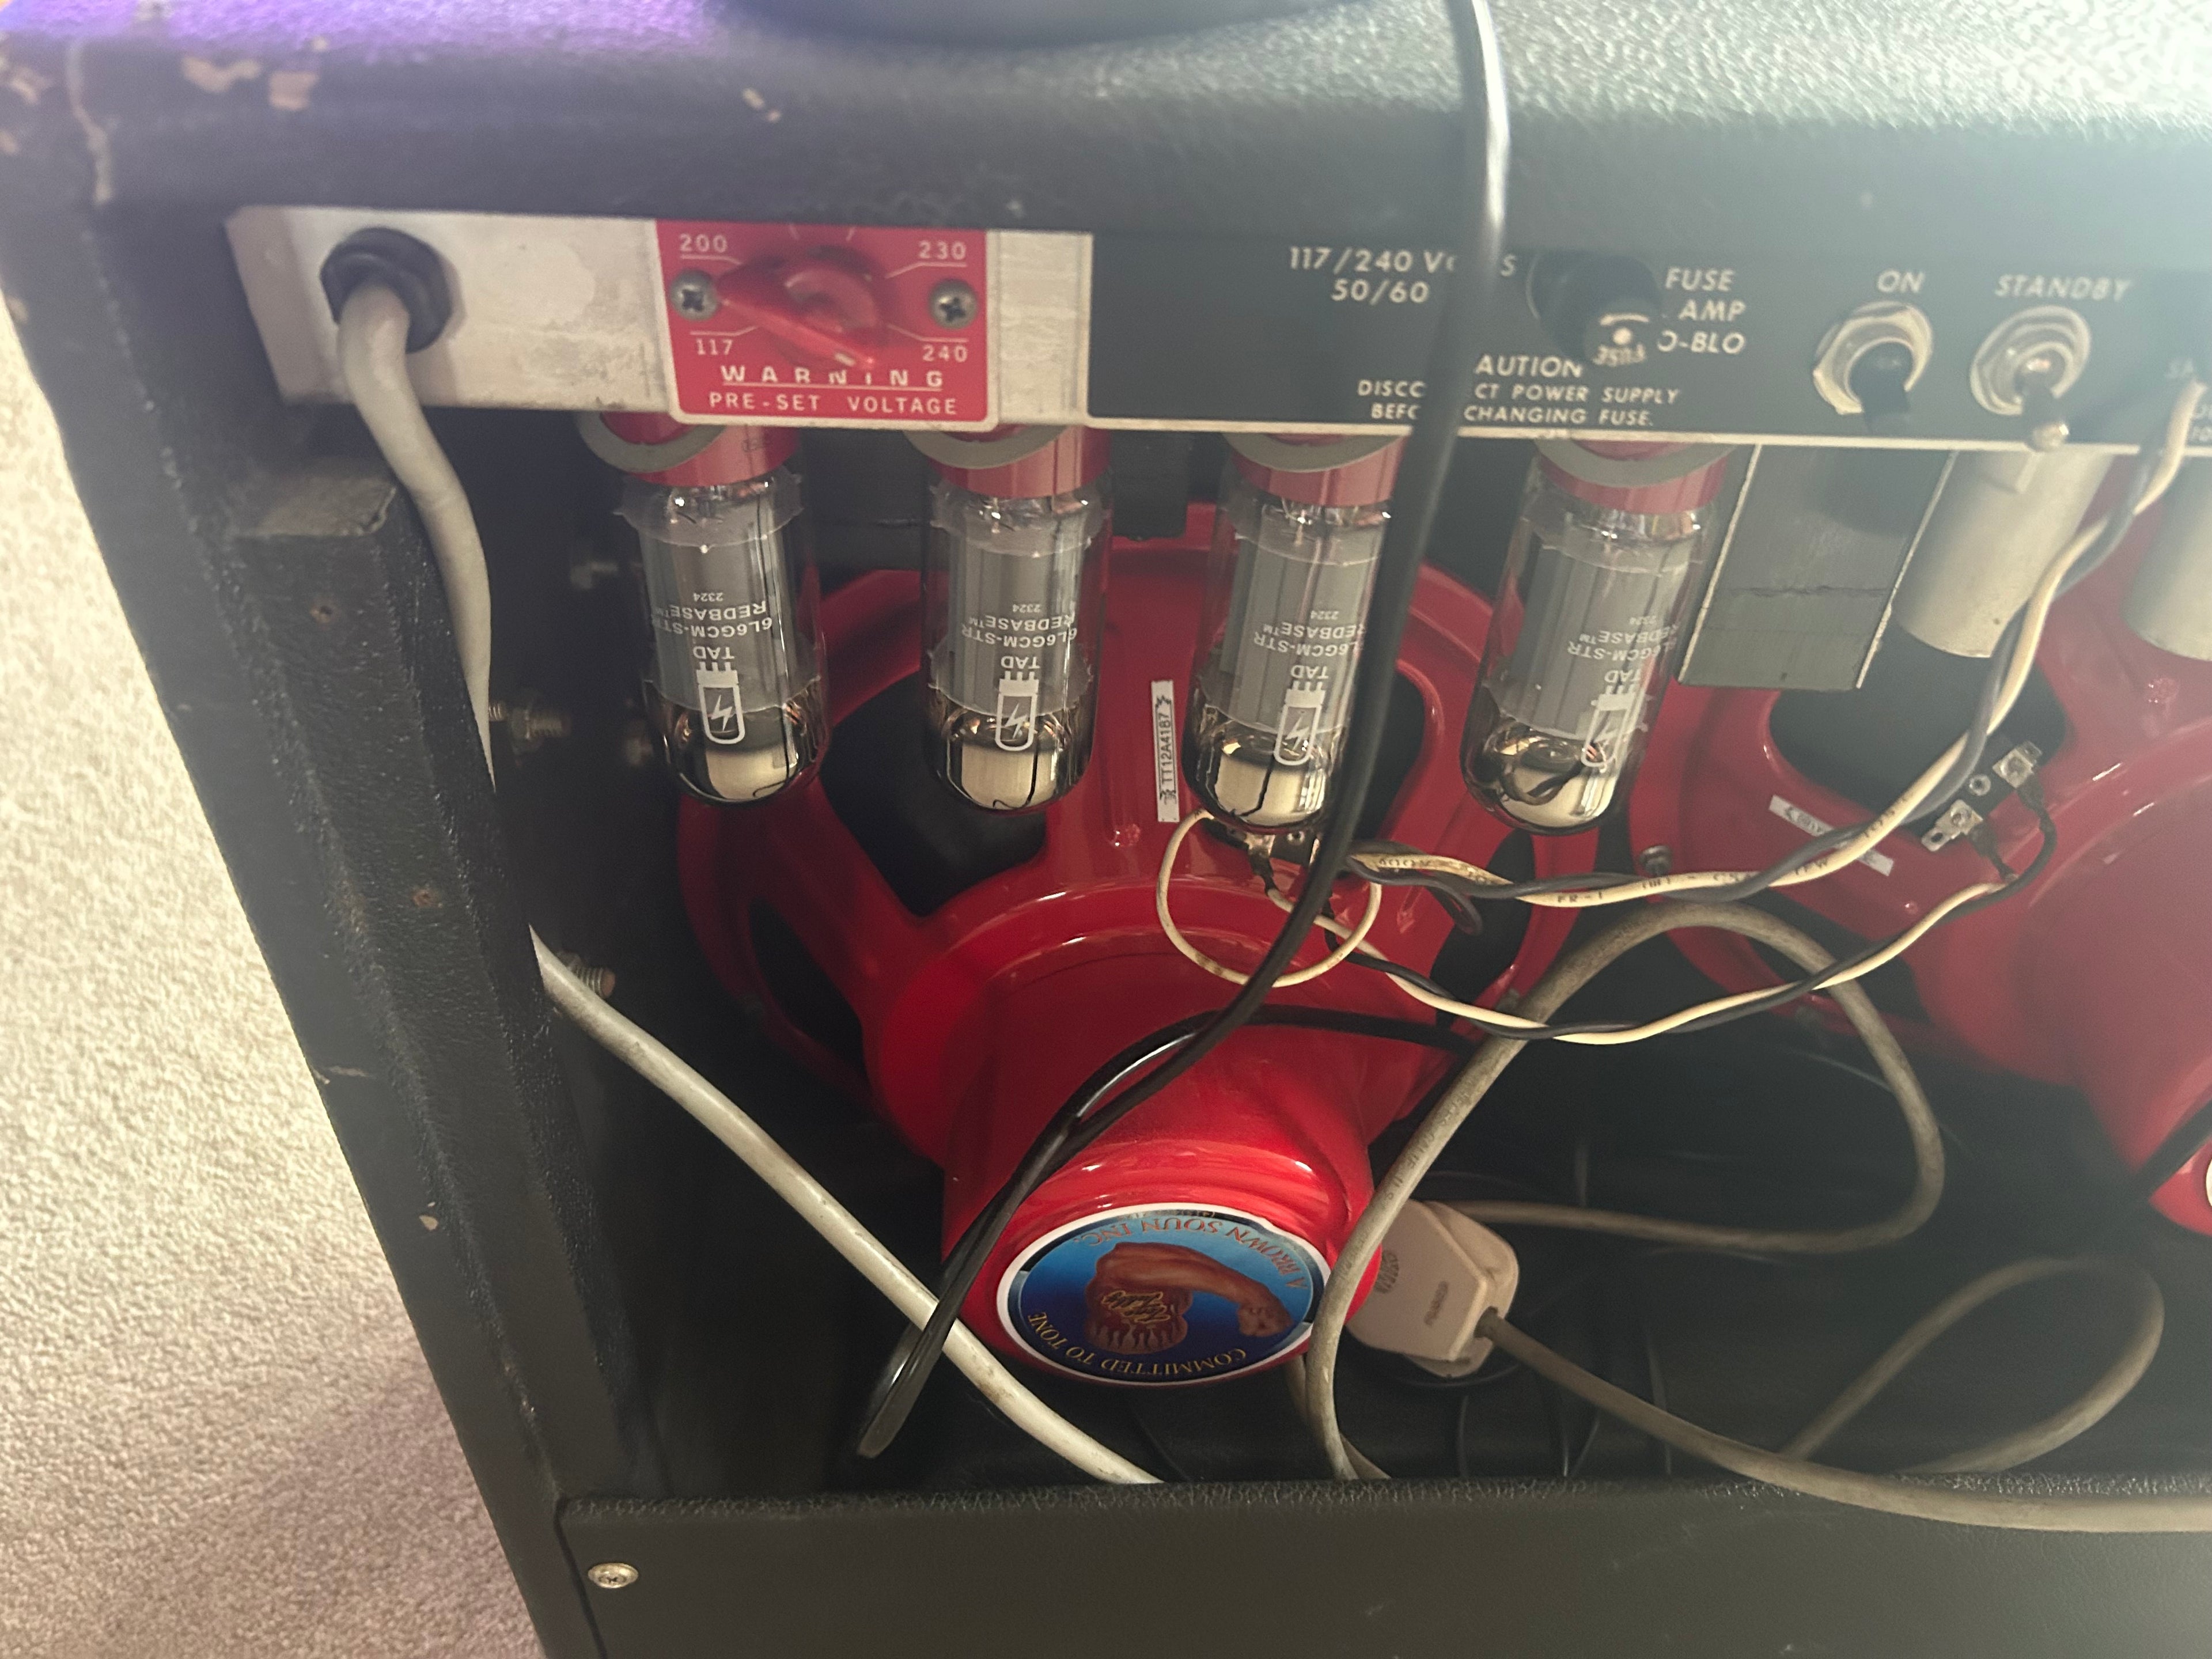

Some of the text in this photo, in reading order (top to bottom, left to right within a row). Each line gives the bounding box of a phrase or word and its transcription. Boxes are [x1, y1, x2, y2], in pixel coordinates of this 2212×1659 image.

[680, 234, 728, 252] 200
[919, 241, 966, 259] 230
[1290, 247, 1414, 274] 117/240
[1665, 266, 1735, 291] FUSE
[1876, 268, 1925, 294] ON
[1994, 272, 2133, 301] STANDBY
[1331, 278, 1430, 305] 50/60
[1677, 299, 1746, 321] AMP
[696, 339, 733, 355] 117
[923, 346, 968, 362] 240
[1474, 354, 1584, 377] AUTION
[721, 366, 943, 387] WARNING
[1511, 382, 1590, 402] POWER
[1601, 387, 1680, 404] SUPPLY
[847, 397, 957, 414] VOLTAGE
[1463, 405, 1586, 424] CHANGING
[693, 592, 724, 602] 2324
[1012, 604, 1041, 613] 2324
[692, 646, 735, 660] TAD
[1001, 656, 1040, 669] TAD
[1290, 665, 1328, 679] TAD
[1604, 669, 1642, 683] TAD
[1158, 713, 1173, 783] TT12A4187
[1141, 1217, 1222, 1233] SOUN
[1226, 1225, 1301, 1276] BROWN
[1285, 1276, 1308, 1290] A
[1027, 1311, 1247, 1376] COMMITTED TO TONE
